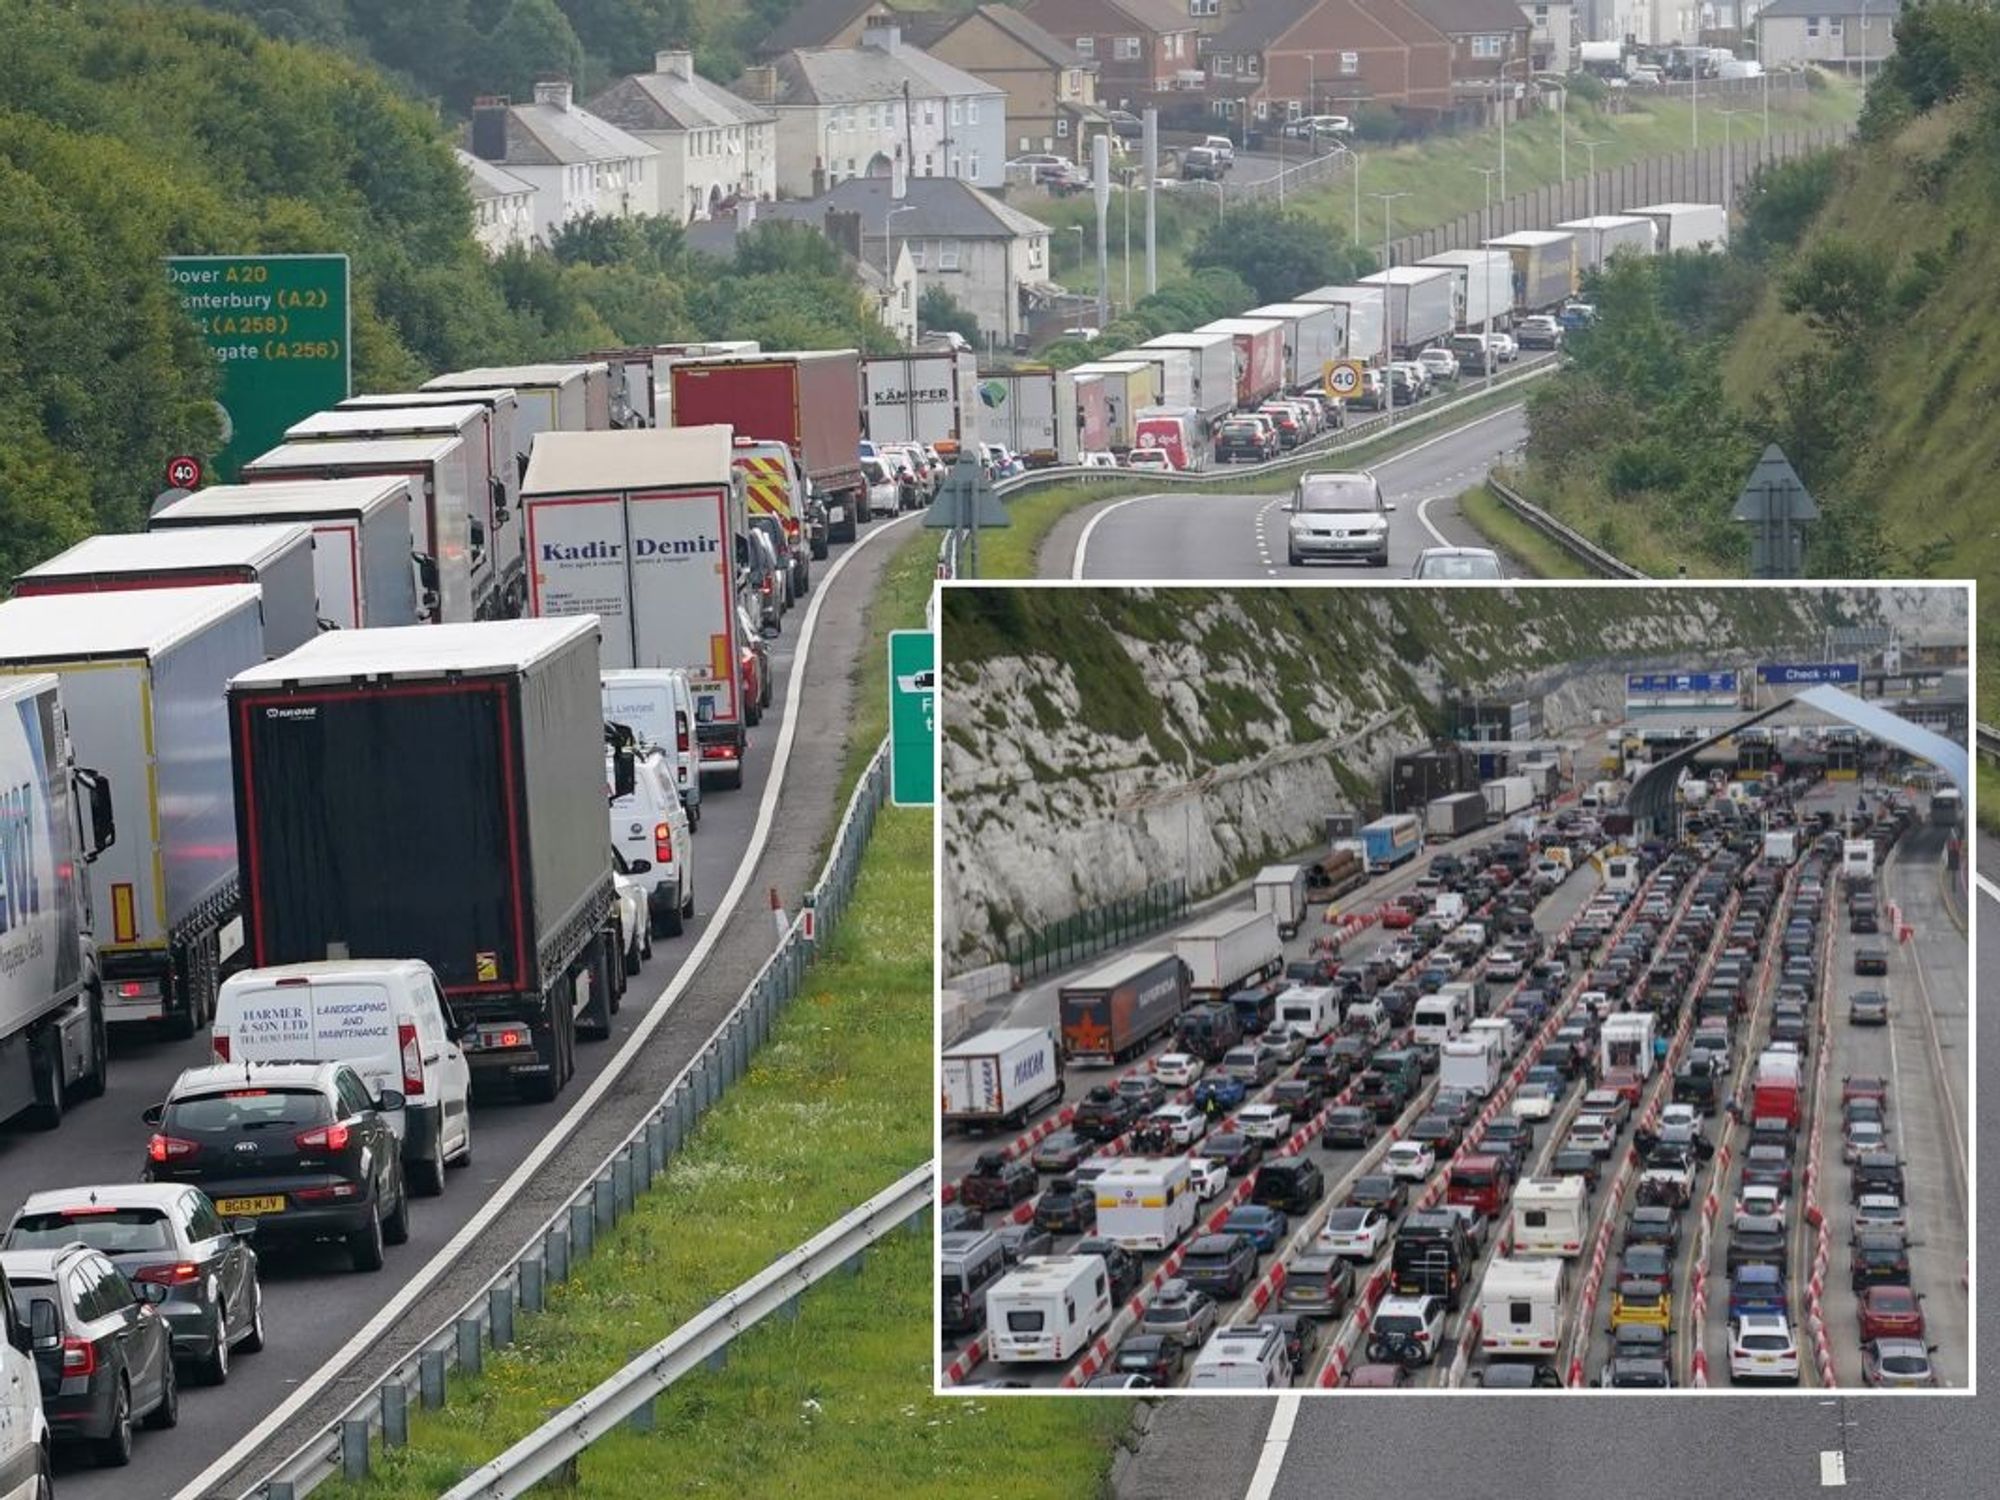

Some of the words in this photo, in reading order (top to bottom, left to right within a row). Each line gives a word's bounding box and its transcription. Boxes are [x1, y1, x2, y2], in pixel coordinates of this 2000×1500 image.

[226, 266, 268, 283] A20
[181, 293, 271, 310] anterbury
[277, 290, 328, 309] (A2)
[213, 316, 288, 334] (A258)
[1333, 373, 1354, 385] 40
[874, 388, 948, 400] KÄMPFER
[174, 466, 194, 479] 40
[543, 541, 622, 561] Kadir
[636, 535, 720, 556] Demir
[1786, 669, 1819, 680] Check
[1830, 669, 1840, 679] in
[243, 1008, 302, 1021] HARMER
[317, 1002, 387, 1016] LANDSCAPING
[240, 1023, 247, 1033] &
[252, 1021, 278, 1032] SON
[283, 1020, 308, 1031] LTD
[342, 1016, 363, 1026] AND
[319, 1027, 388, 1038] MAINTENANCE
